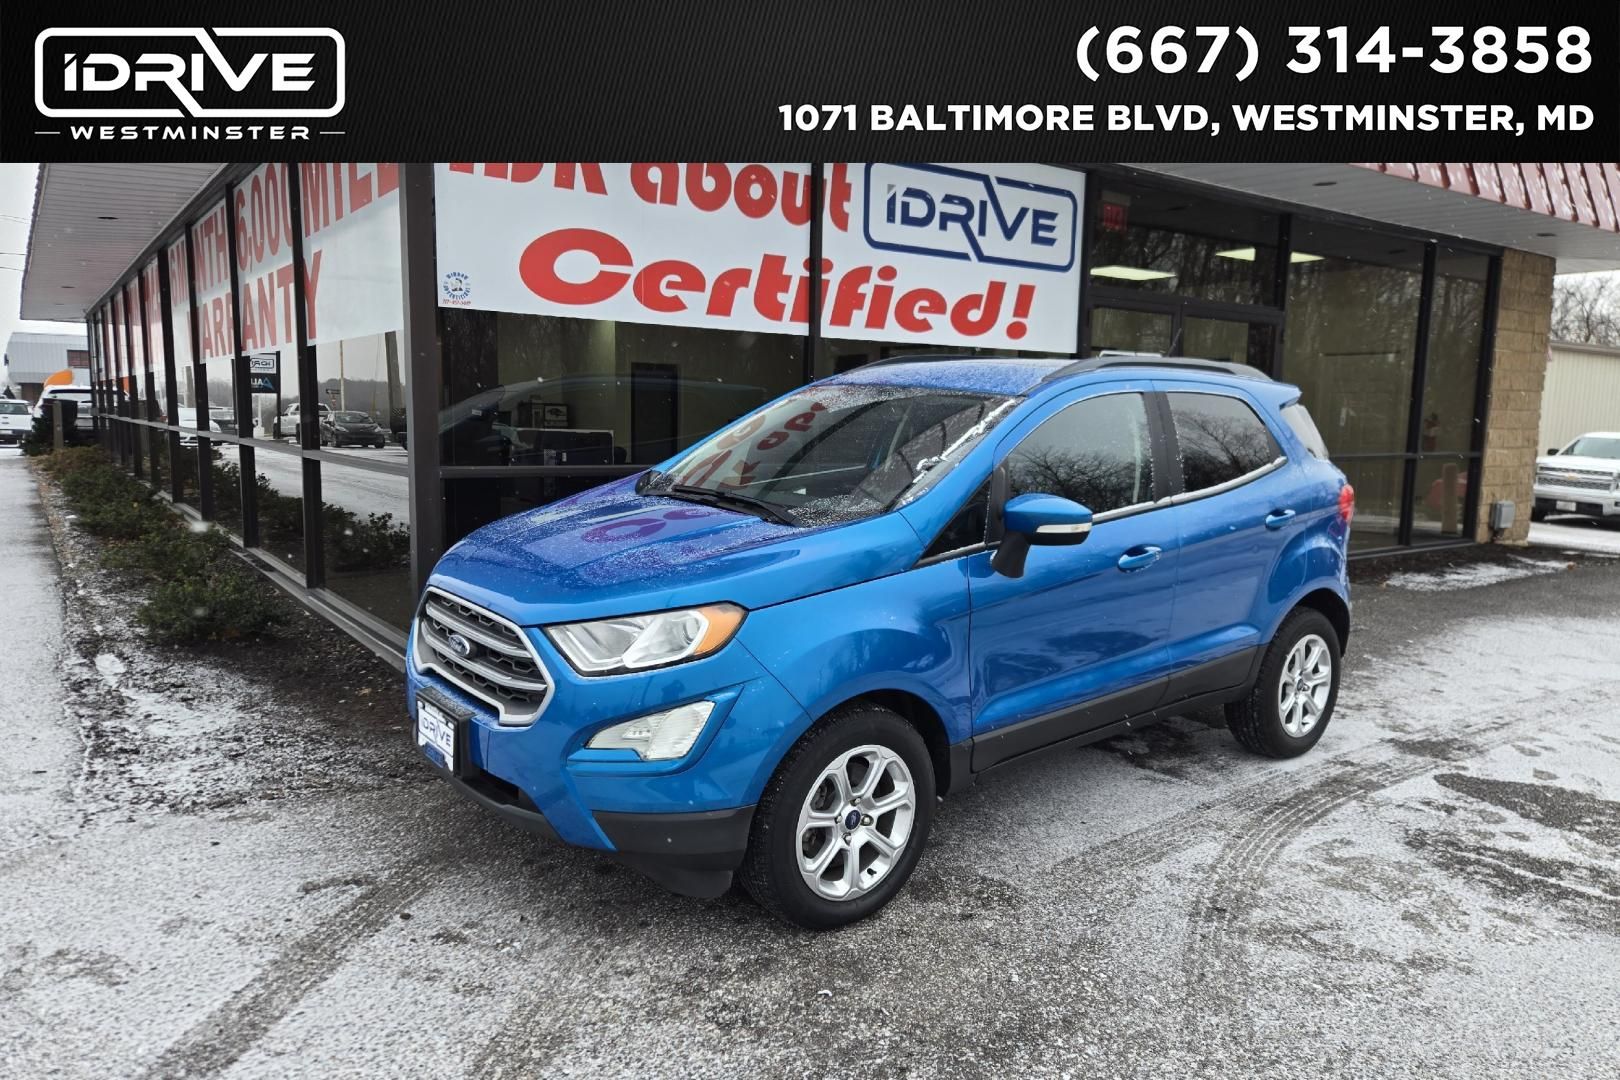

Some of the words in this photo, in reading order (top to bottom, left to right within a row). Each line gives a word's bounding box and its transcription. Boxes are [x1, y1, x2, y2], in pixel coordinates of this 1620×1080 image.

[176, 204, 230, 303] MNTH
[301, 162, 400, 238] MIL
[518, 227, 1036, 341] Certified!
[187, 248, 323, 360] ARRANTY
